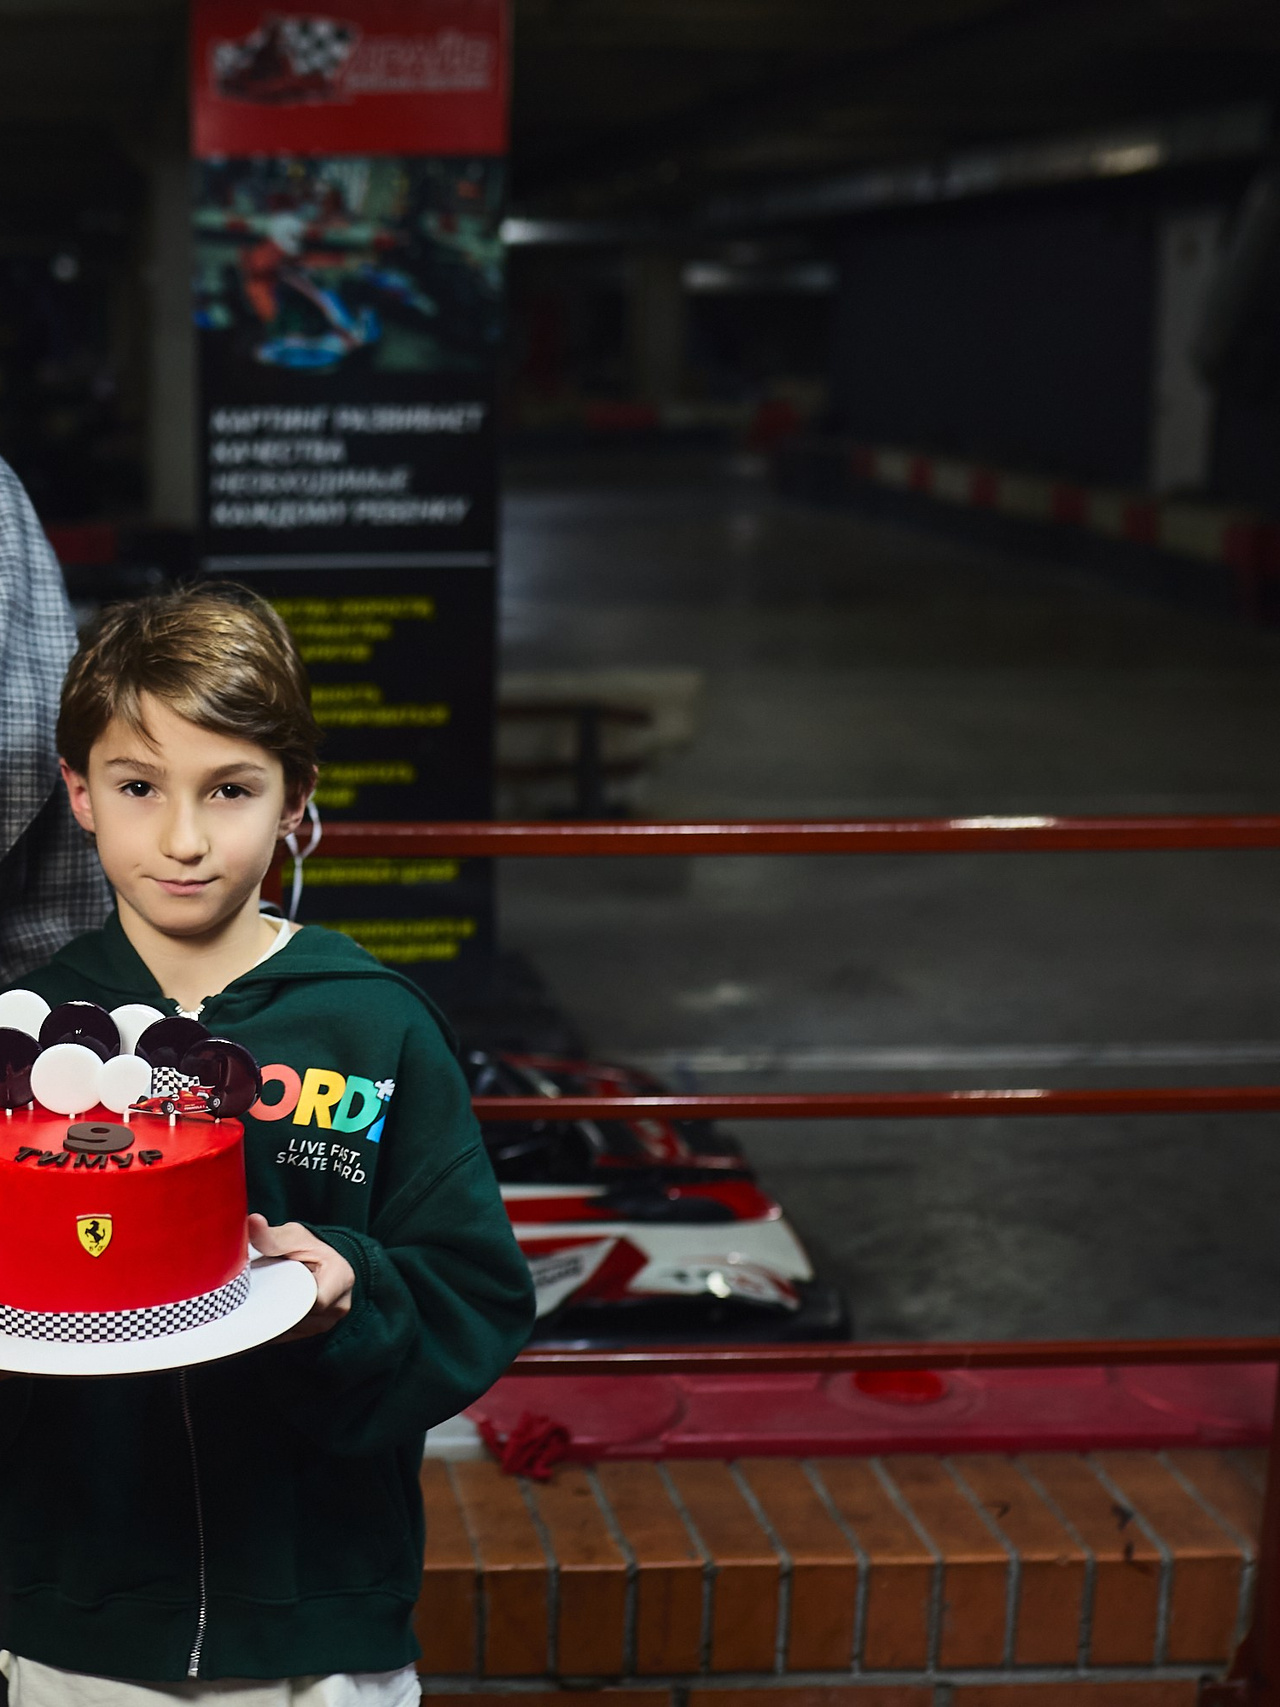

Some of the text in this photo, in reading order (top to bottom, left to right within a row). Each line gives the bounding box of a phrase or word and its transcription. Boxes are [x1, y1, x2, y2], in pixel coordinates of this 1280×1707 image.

[249, 1063, 389, 1143] ORD
[63, 1121, 135, 1154] 9
[288, 1138, 327, 1156] LIVE
[15, 1146, 163, 1169] ТИМУР
[276, 1151, 367, 1185] SKATE HRD.
